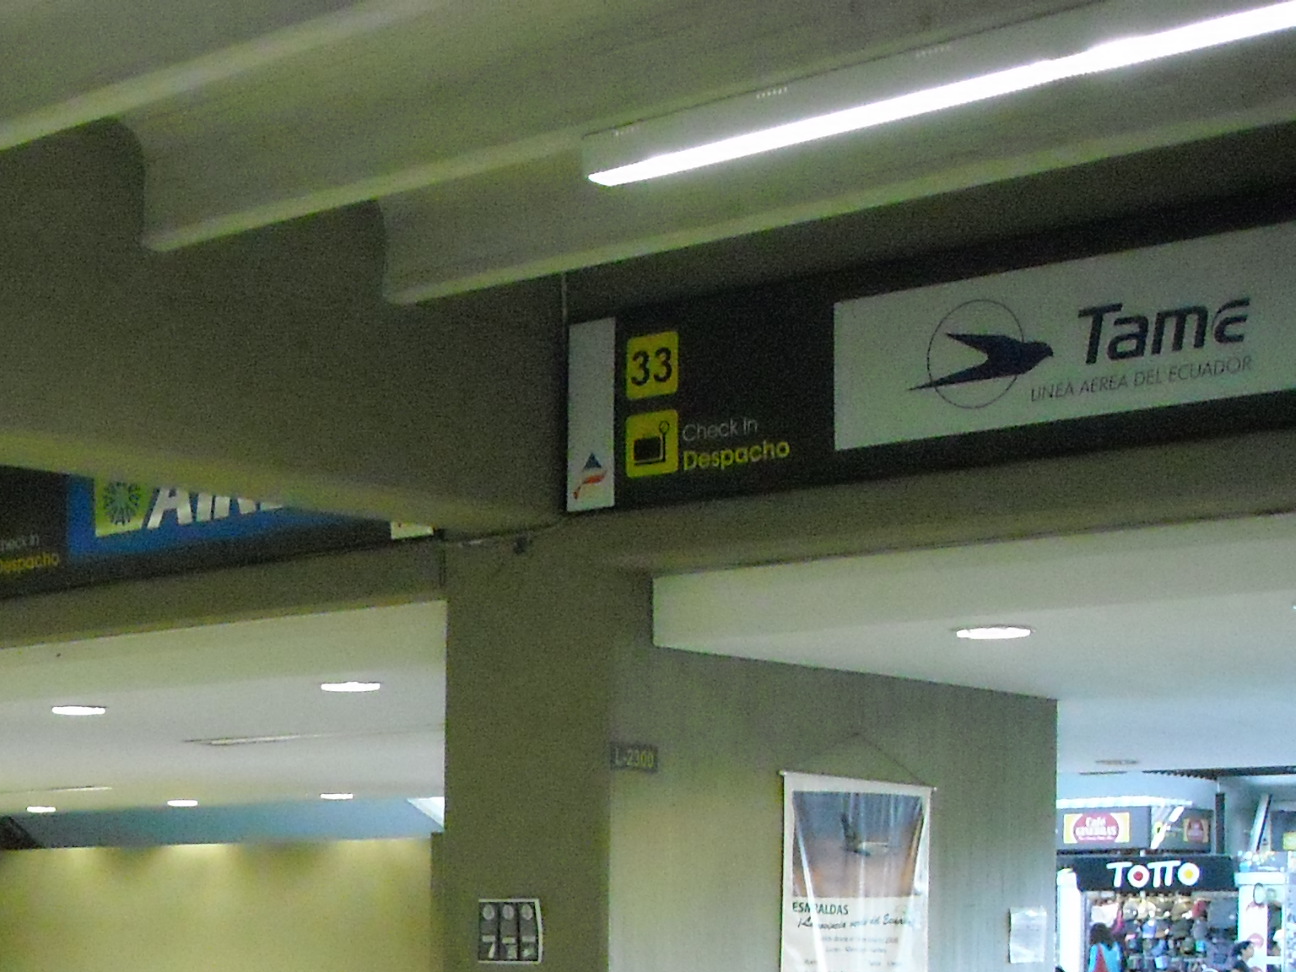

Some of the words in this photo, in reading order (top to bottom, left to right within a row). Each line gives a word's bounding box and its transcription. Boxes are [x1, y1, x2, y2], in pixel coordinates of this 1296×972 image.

[1078, 297, 1251, 364] Tame
[631, 347, 673, 386] 33
[1134, 370, 1163, 387] DEL
[1168, 355, 1254, 380] ECUADOR
[682, 418, 739, 442] Check
[683, 440, 791, 471] Despacho
[1106, 860, 1200, 888] TOTTO
